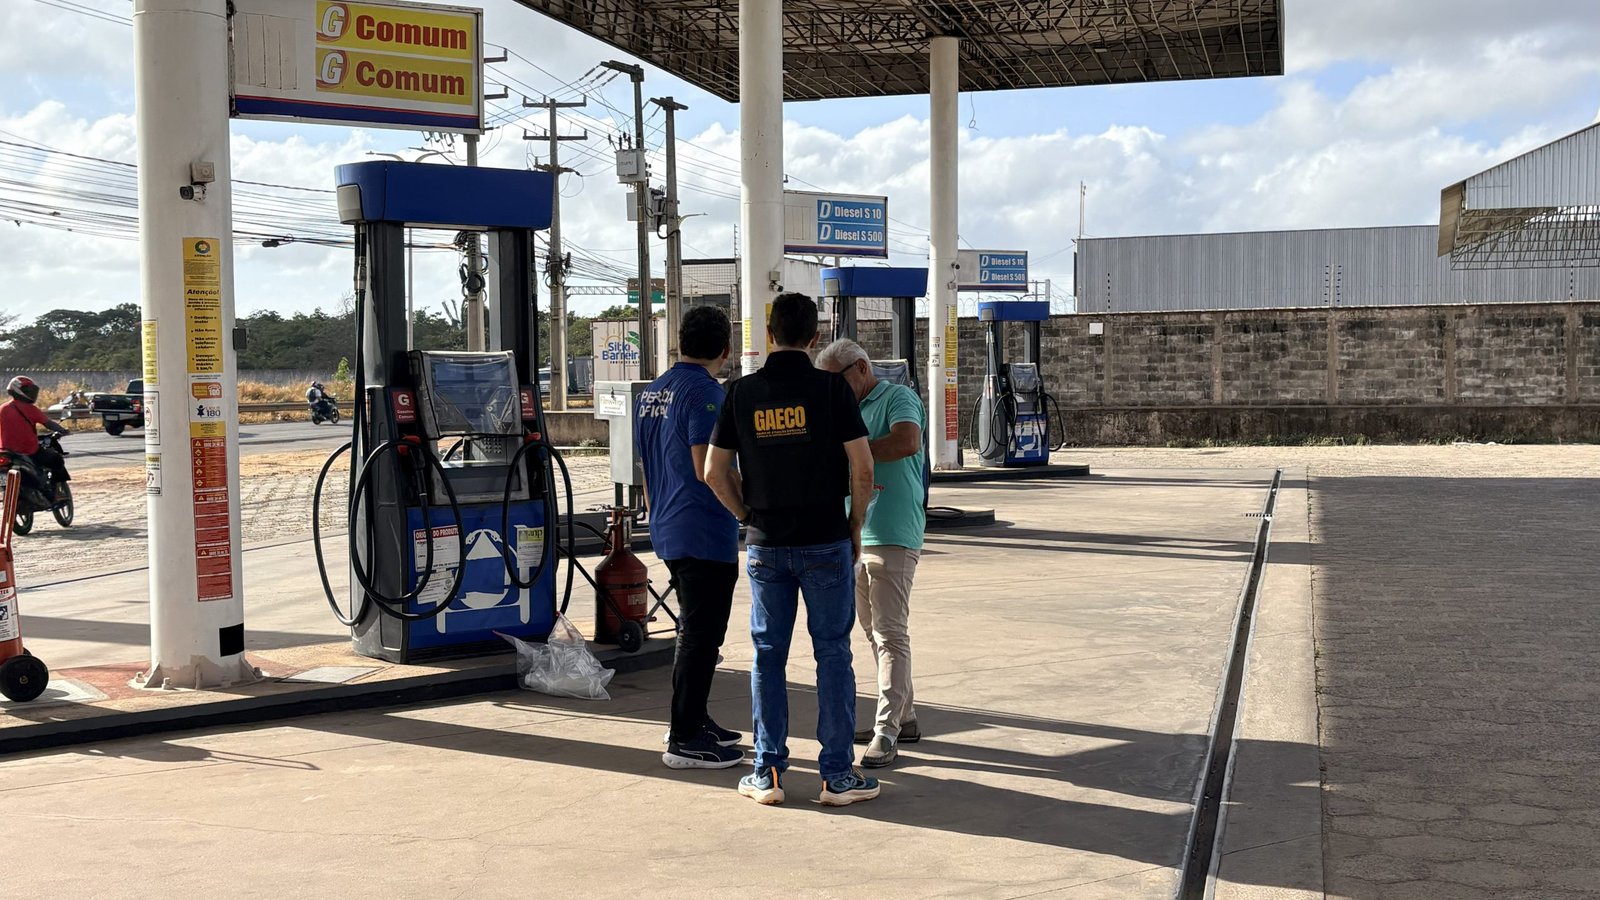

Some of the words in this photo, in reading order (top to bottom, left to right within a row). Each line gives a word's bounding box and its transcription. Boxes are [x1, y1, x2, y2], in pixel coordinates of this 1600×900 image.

[320, 5, 344, 39] G
[355, 14, 467, 50] Comum
[320, 52, 344, 85] G
[355, 60, 465, 96] Comum
[819, 201, 832, 219] D
[834, 205, 863, 218] Diesel
[864, 208, 871, 219] S
[872, 208, 882, 220] 10
[819, 223, 832, 241] D
[834, 229, 860, 241] Diesel
[861, 230, 867, 241] S
[868, 231, 883, 242] 500
[980, 255, 989, 267] D
[991, 257, 1011, 266] Diesel
[1012, 258, 1017, 266] S
[1017, 258, 1024, 266] 10
[980, 270, 989, 282] D
[991, 272, 1010, 281] Diesel
[1015, 273, 1026, 282] 500
[186, 288, 220, 296] Atenção!
[397, 393, 410, 407] G
[206, 409, 221, 417] 180
[754, 406, 806, 431] GAECO
